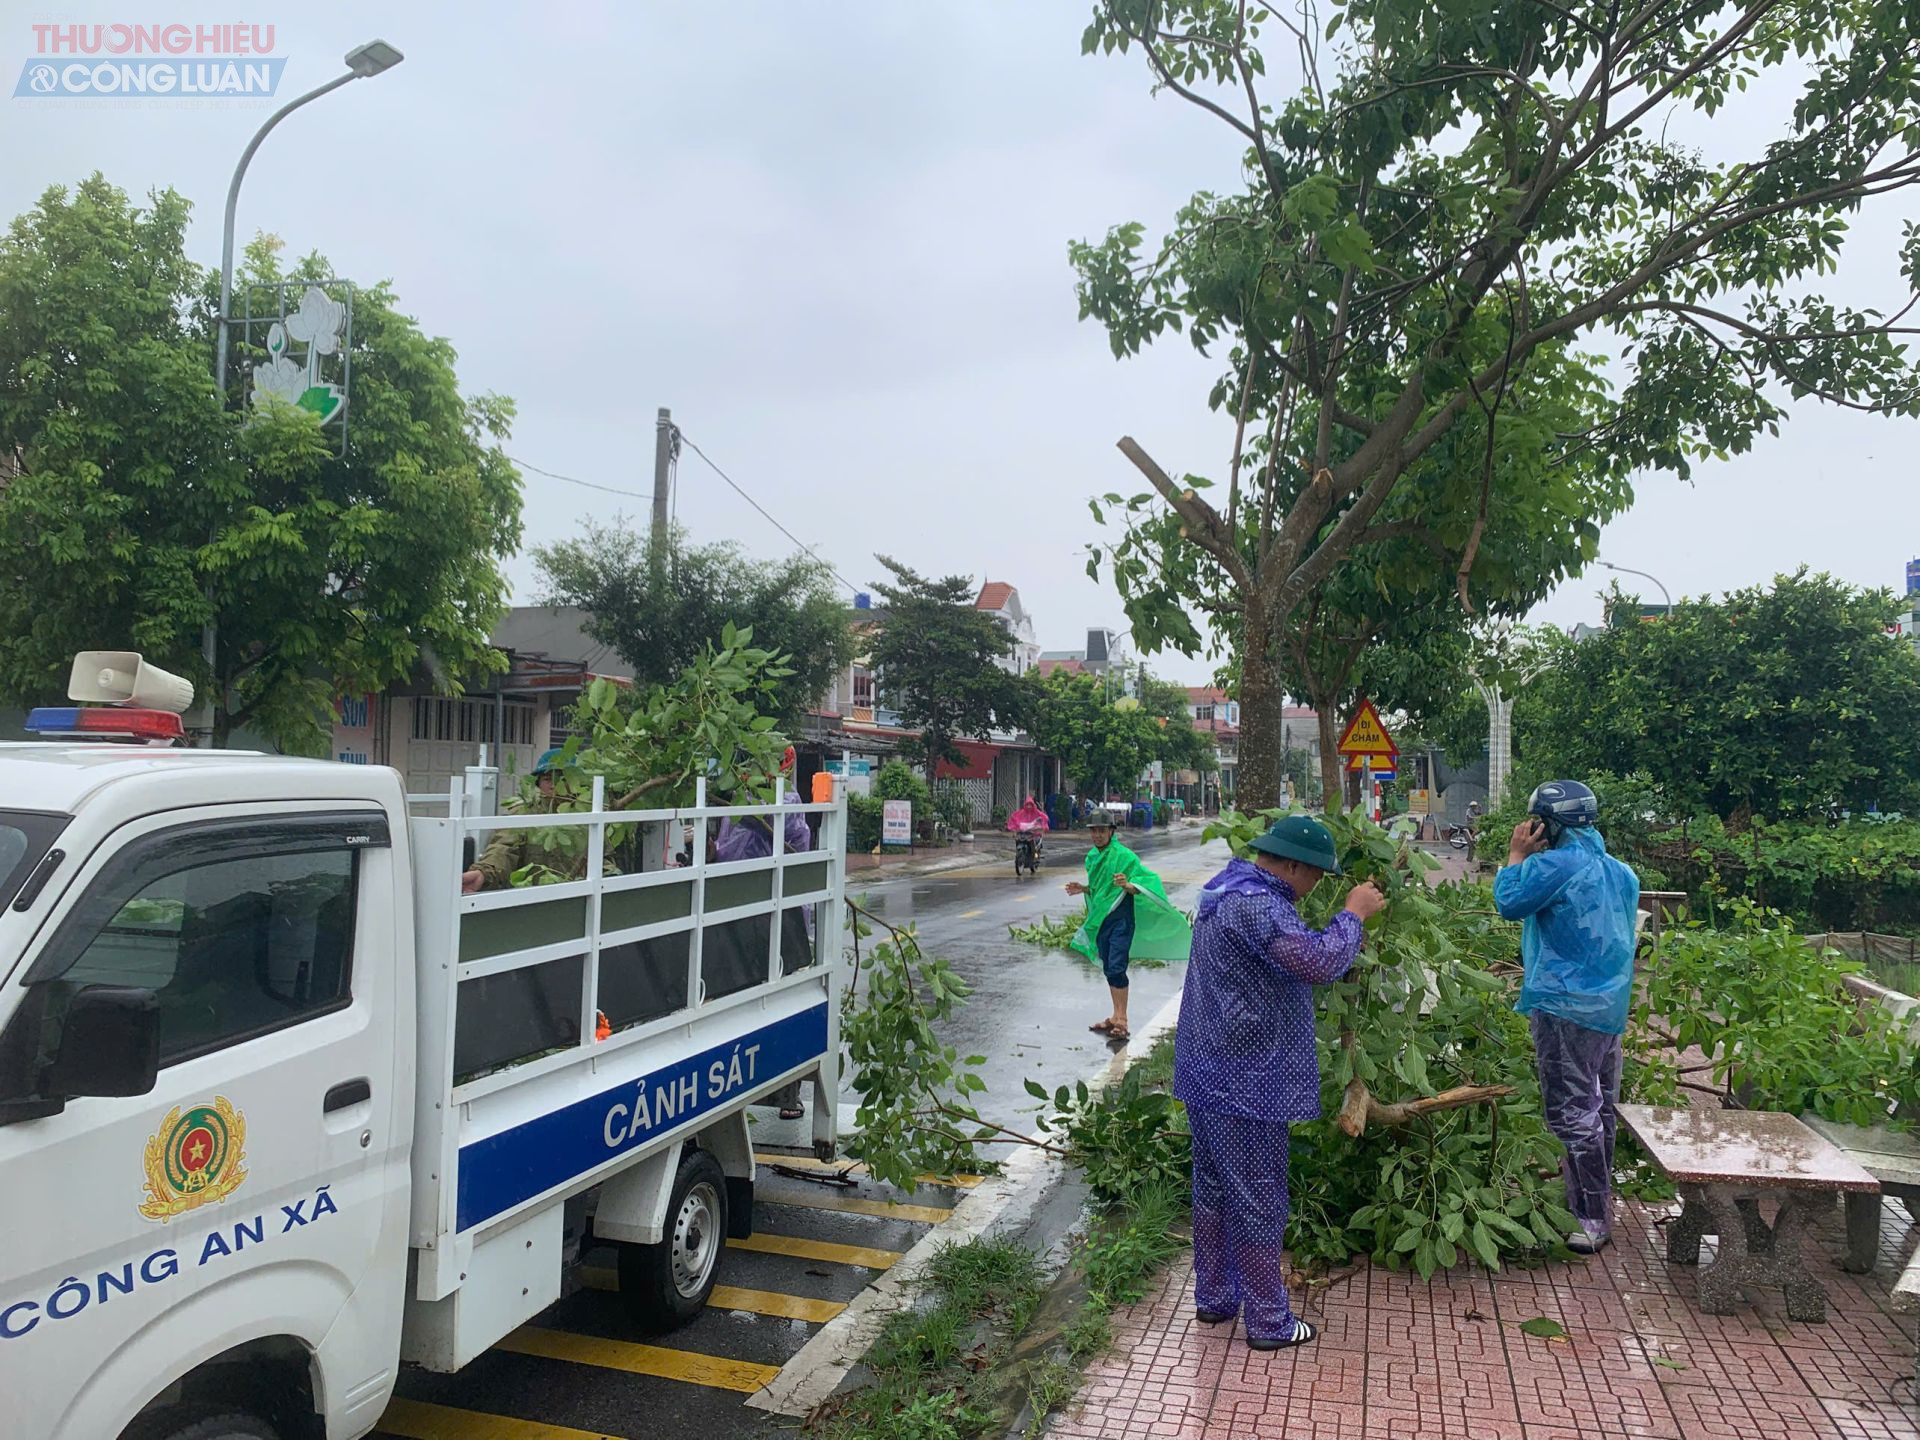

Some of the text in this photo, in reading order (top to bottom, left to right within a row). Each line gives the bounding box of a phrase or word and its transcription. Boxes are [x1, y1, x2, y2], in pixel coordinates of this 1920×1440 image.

[603, 1043, 760, 1148] CẢNH SÁT
[0, 1184, 338, 1339] CÔNG AN XÃ
